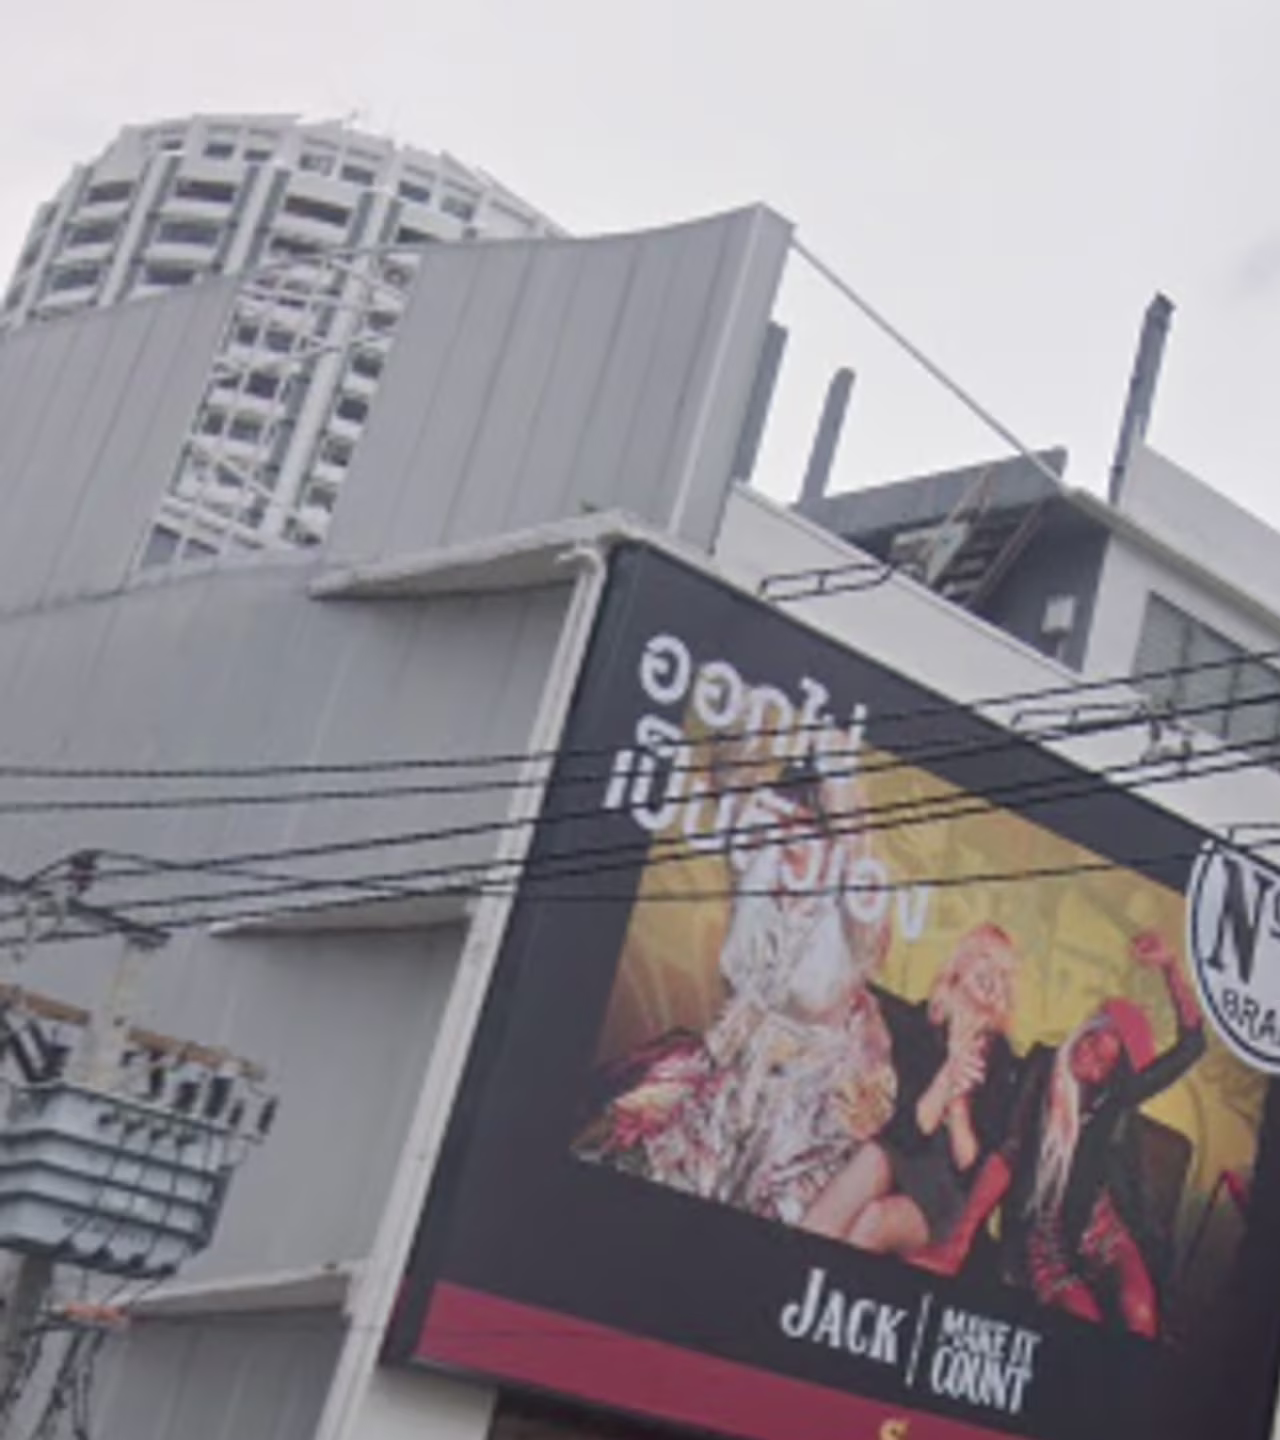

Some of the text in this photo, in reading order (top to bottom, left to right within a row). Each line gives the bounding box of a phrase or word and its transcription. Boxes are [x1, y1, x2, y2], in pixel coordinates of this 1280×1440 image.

[780, 1267, 909, 1364] JACK
[938, 1307, 1042, 1368] MAKE IT
[931, 1345, 1032, 1414] COUNT
